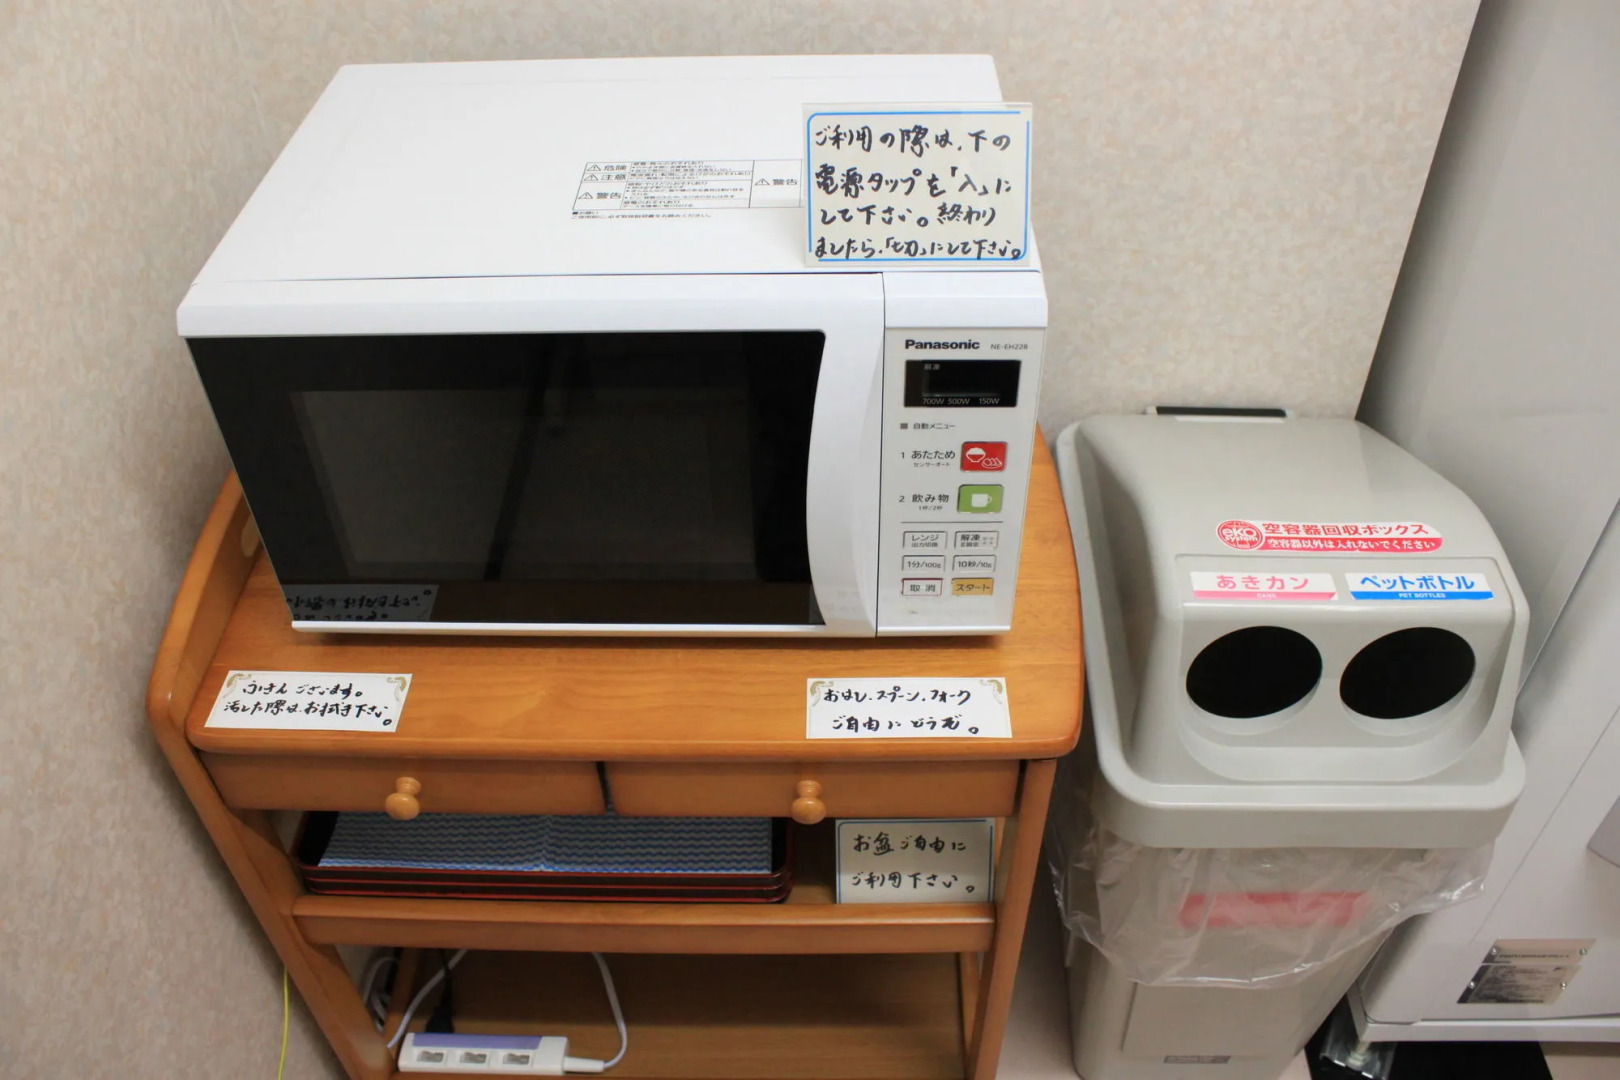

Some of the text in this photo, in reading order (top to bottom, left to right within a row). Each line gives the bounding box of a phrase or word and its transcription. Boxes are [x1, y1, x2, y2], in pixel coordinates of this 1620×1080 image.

[905, 339, 980, 350] Panasonic
[922, 397, 1001, 405] 700W 500W 150W
[913, 422, 956, 430] 自動メニュー
[911, 450, 956, 460] あたため
[898, 493, 950, 503] 2 飲み物
[1262, 522, 1429, 537] 空容器回収ボックス
[911, 533, 939, 541] レンジ
[960, 533, 980, 541] 解凍
[1225, 535, 1258, 543] system
[1267, 538, 1436, 550] 空容器以外は入れないでください
[907, 560, 942, 568] 1分/100g
[957, 560, 992, 568] 10秒/10g
[1216, 574, 1309, 590] あきカン
[1360, 574, 1475, 591] ペットボトル
[909, 584, 936, 592] 取消
[955, 583, 991, 592] スタート
